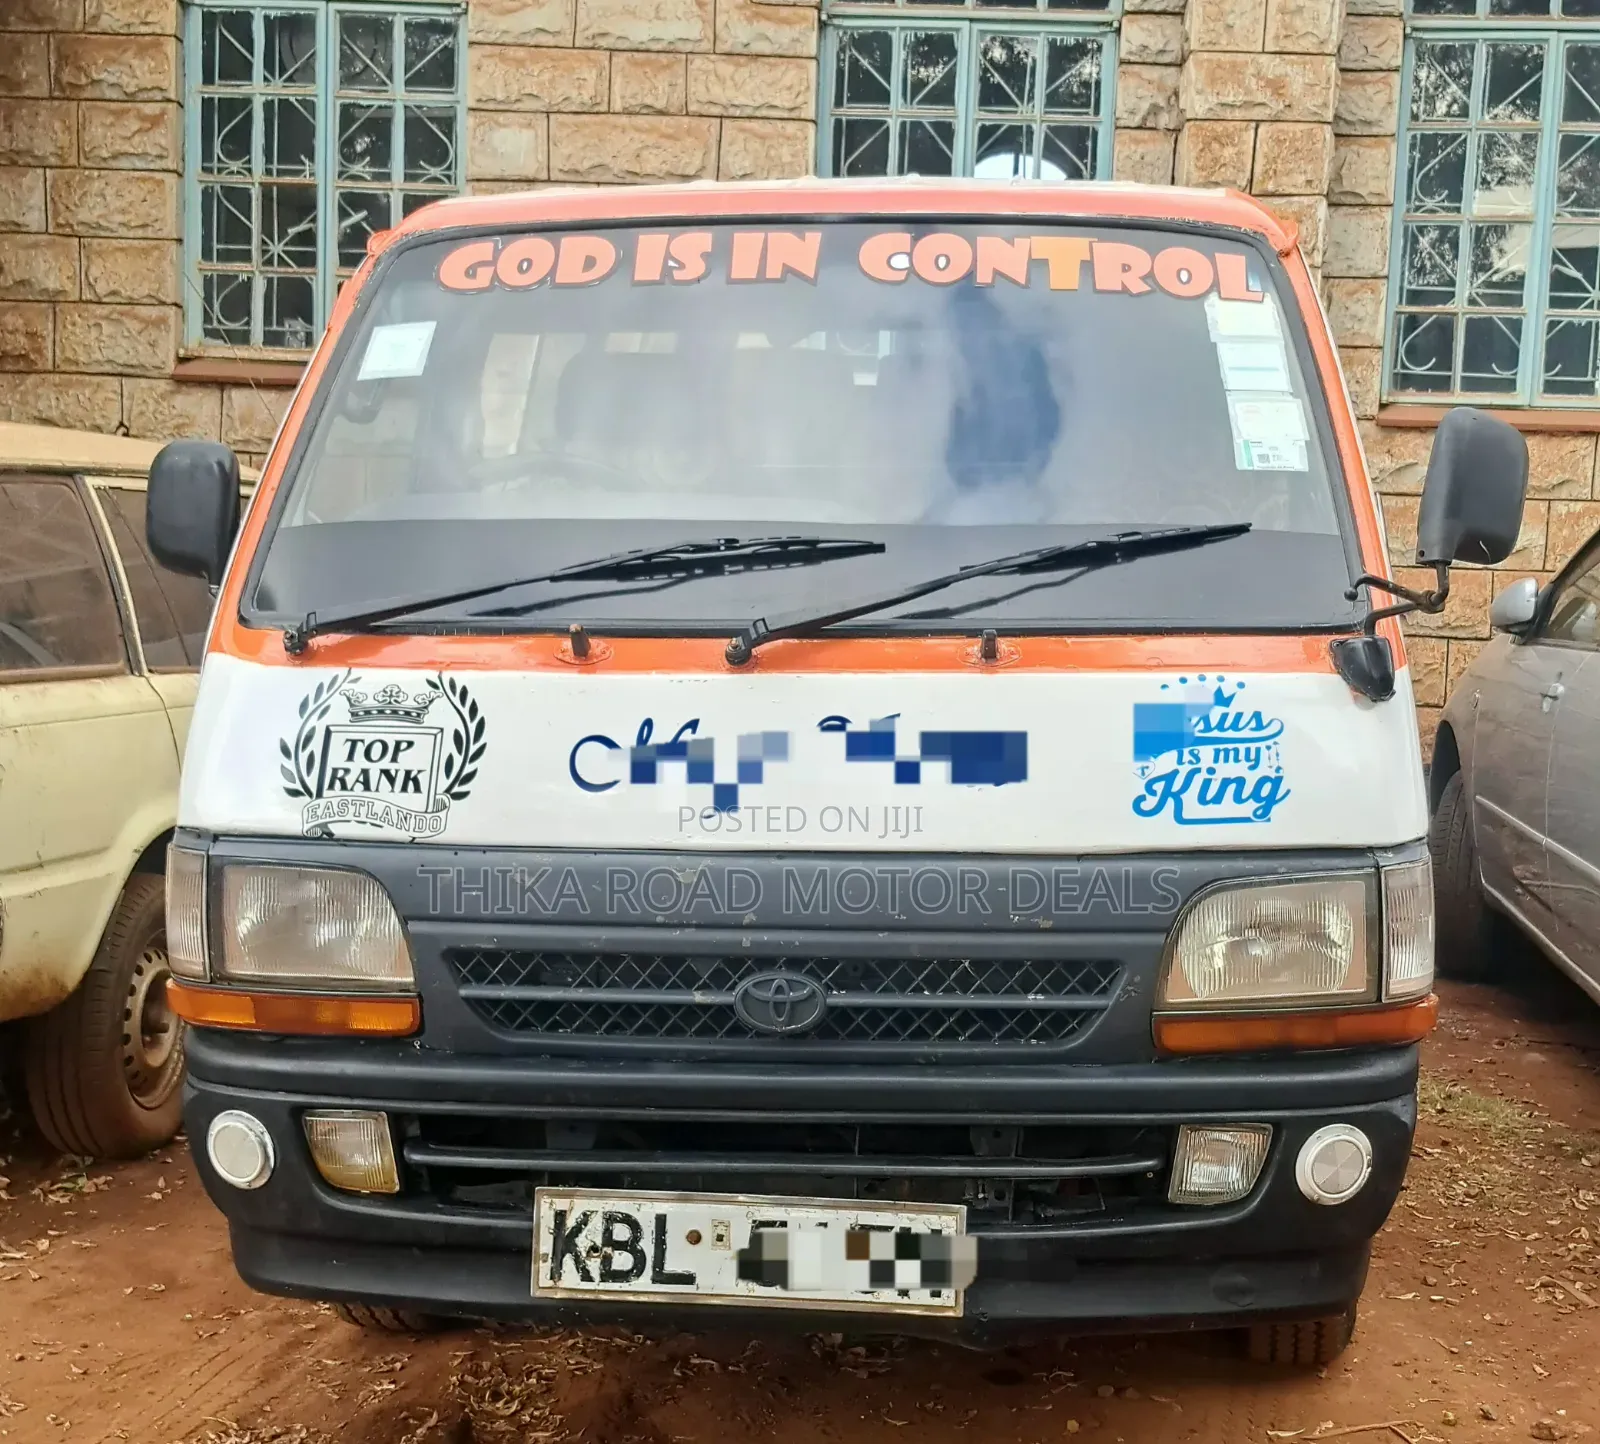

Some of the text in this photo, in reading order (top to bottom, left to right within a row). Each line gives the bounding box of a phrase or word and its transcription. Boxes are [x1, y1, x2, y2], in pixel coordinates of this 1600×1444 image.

[437, 231, 1265, 302] GOD IS IN CONTROL
[343, 738, 415, 763] TOP
[1213, 747, 1262, 771] my
[326, 767, 427, 794] RANK
[1132, 767, 1291, 825] King
[306, 799, 443, 833] EASTLANDO
[550, 1208, 697, 1285] KBL
